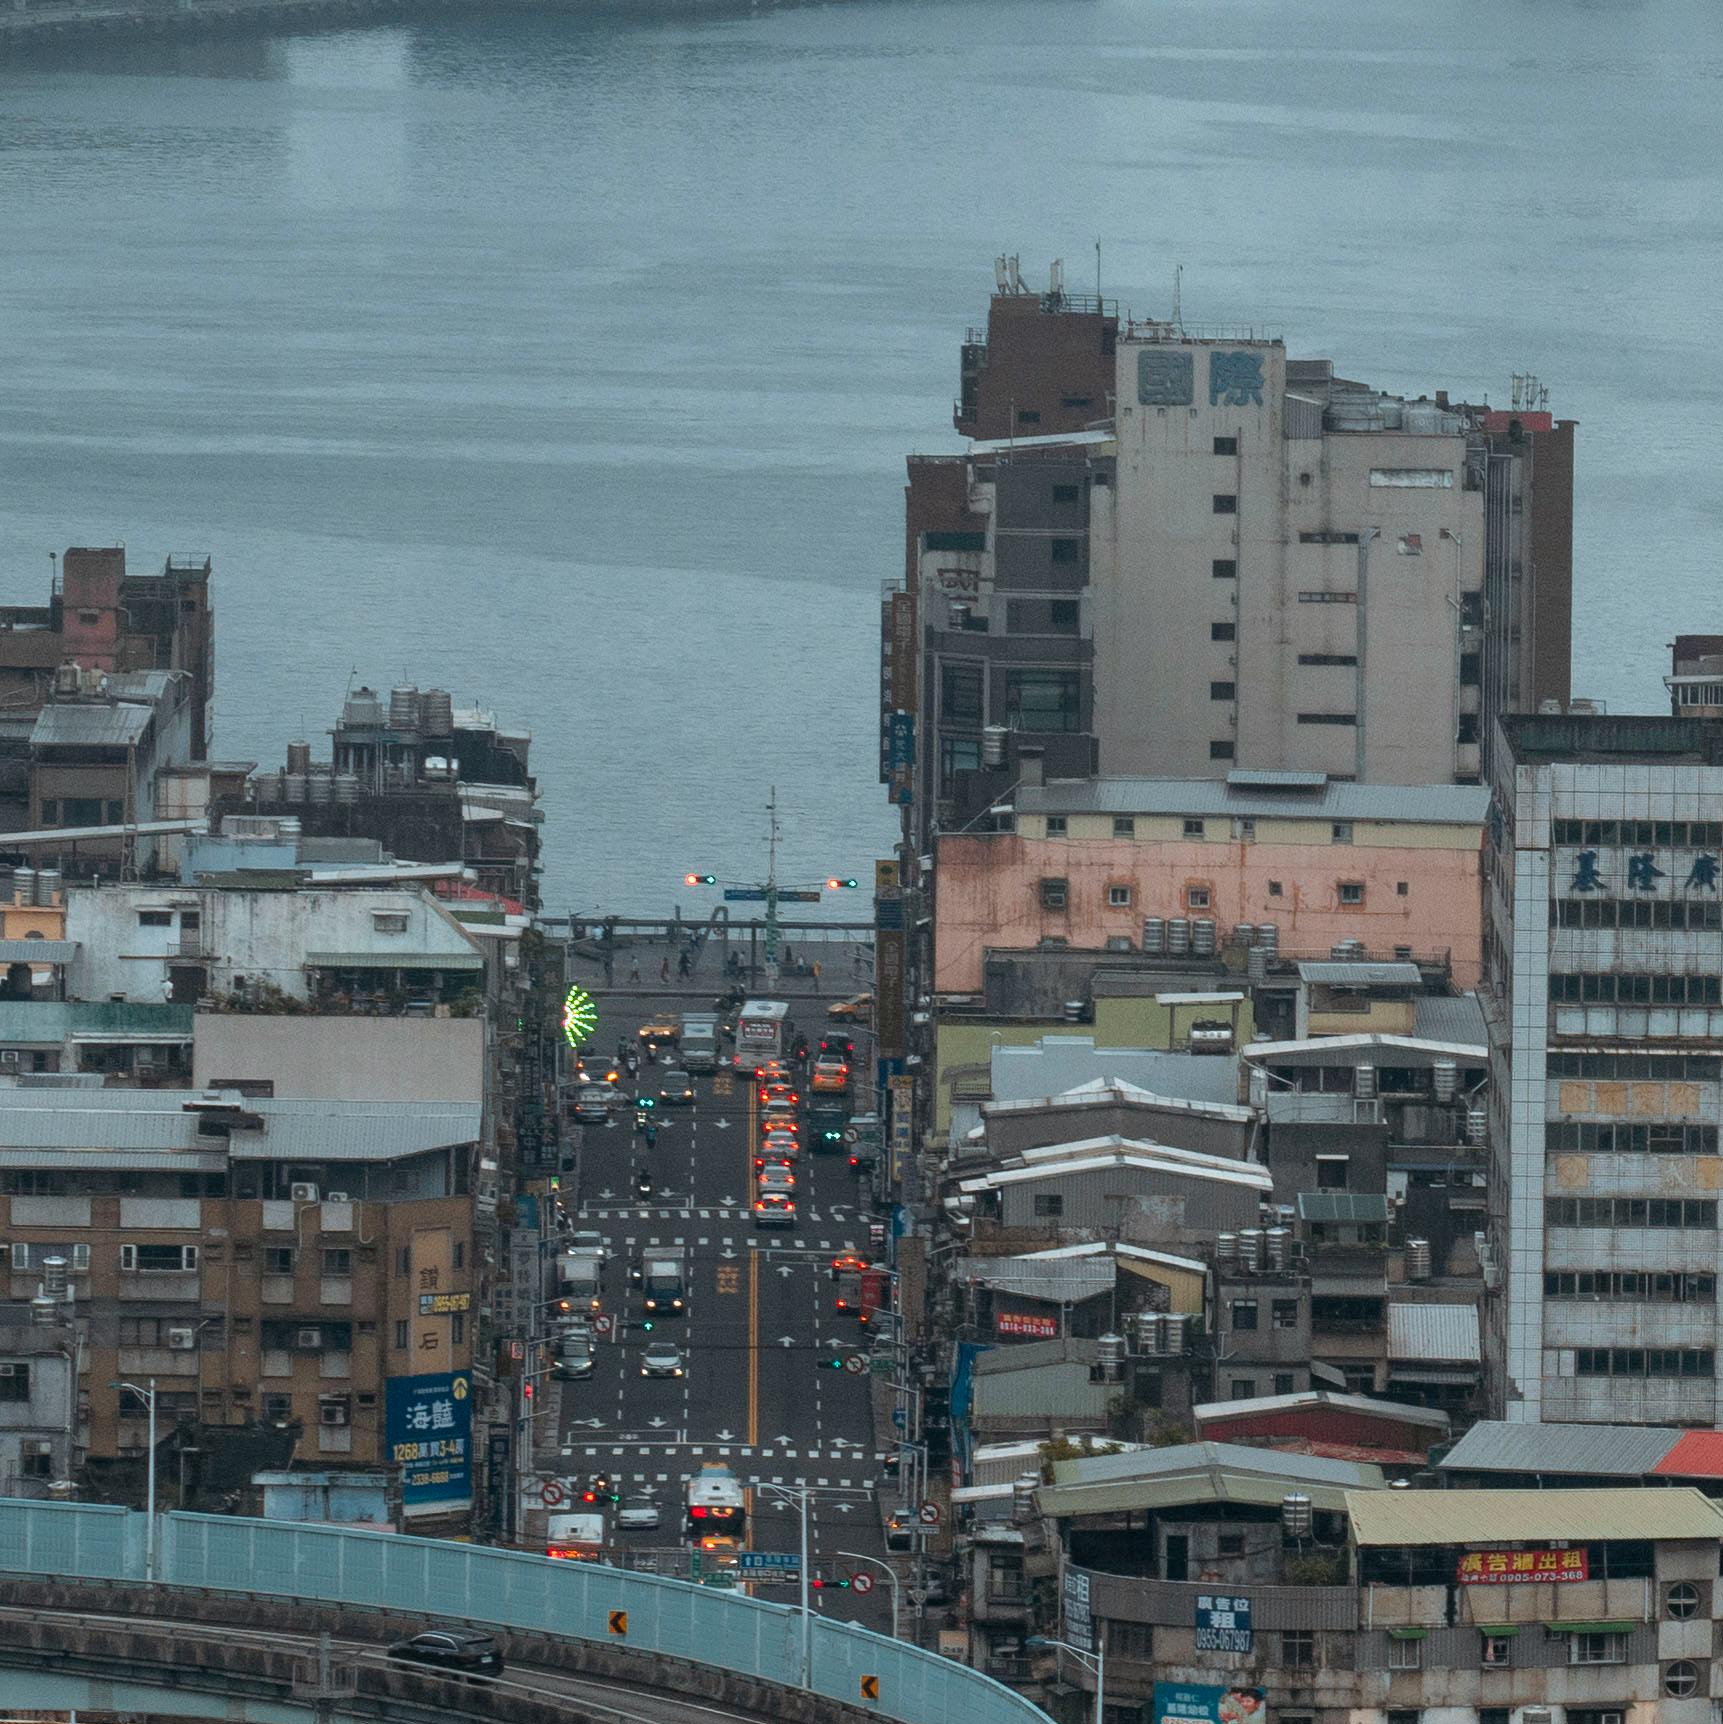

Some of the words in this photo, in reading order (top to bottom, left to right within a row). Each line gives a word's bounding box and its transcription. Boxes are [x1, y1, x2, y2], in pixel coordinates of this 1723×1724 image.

[1463, 1551, 1582, 1572] 廣告牆出租
[1198, 1597, 1250, 1612] 廣告位
[1210, 1612, 1236, 1628] 租
[1196, 1628, 1251, 1651] 0955-067987
